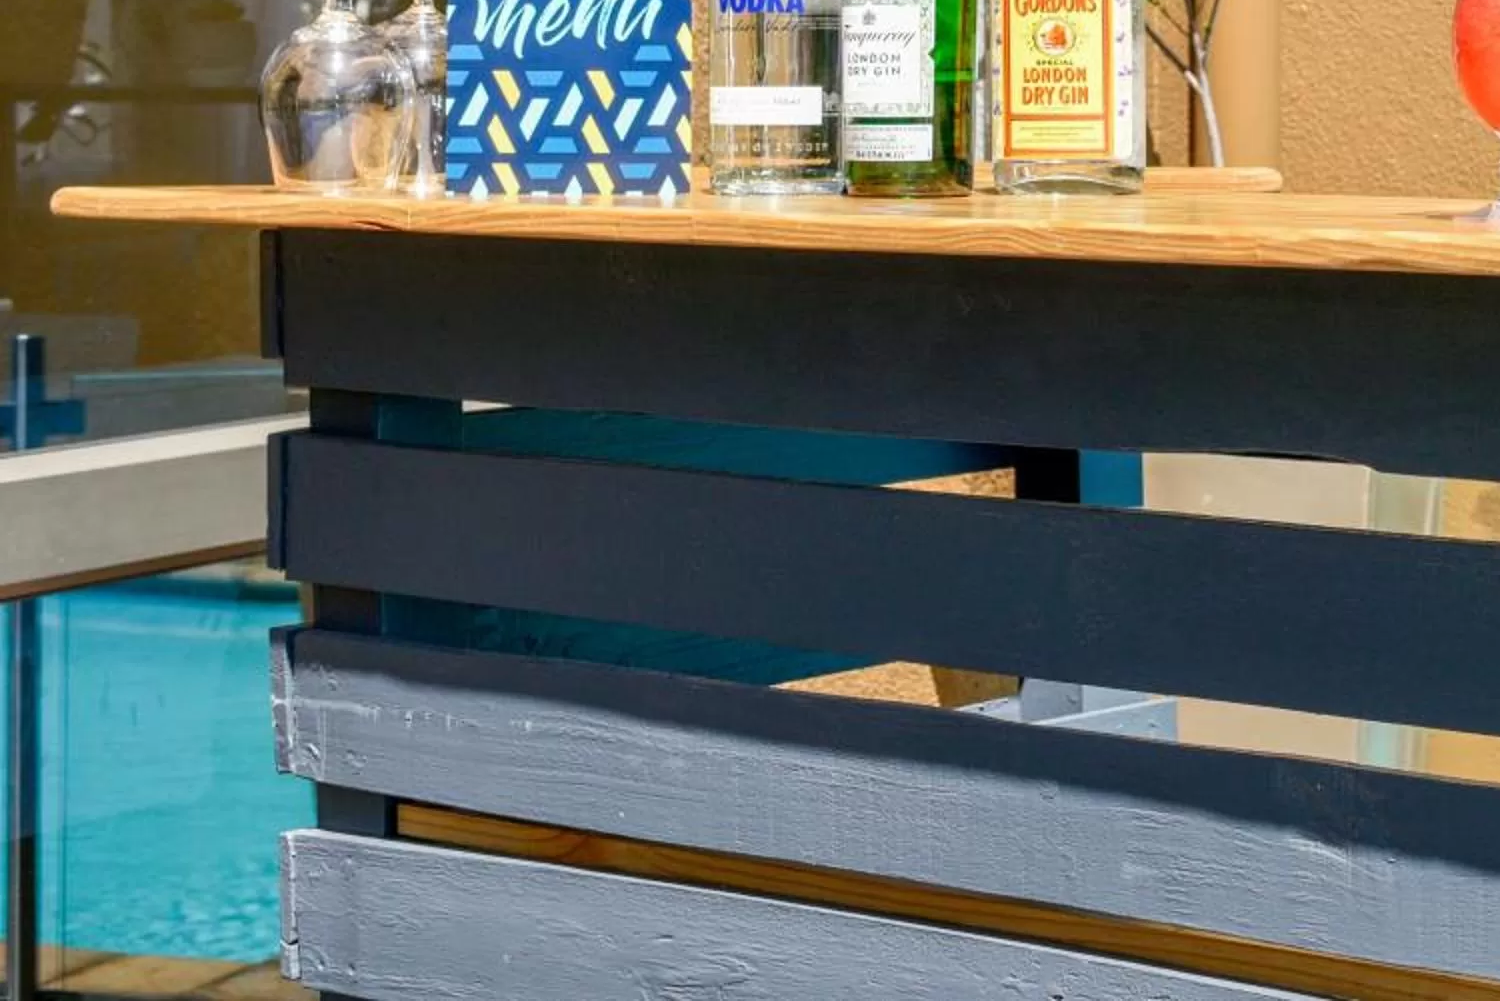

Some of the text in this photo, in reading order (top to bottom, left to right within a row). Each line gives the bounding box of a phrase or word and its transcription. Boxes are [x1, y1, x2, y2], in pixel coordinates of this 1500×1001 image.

[848, 52, 901, 63] LONDON
[873, 66, 901, 76] GIN
[1023, 66, 1087, 83] LONDON
[1021, 85, 1089, 105] DRY GIN
